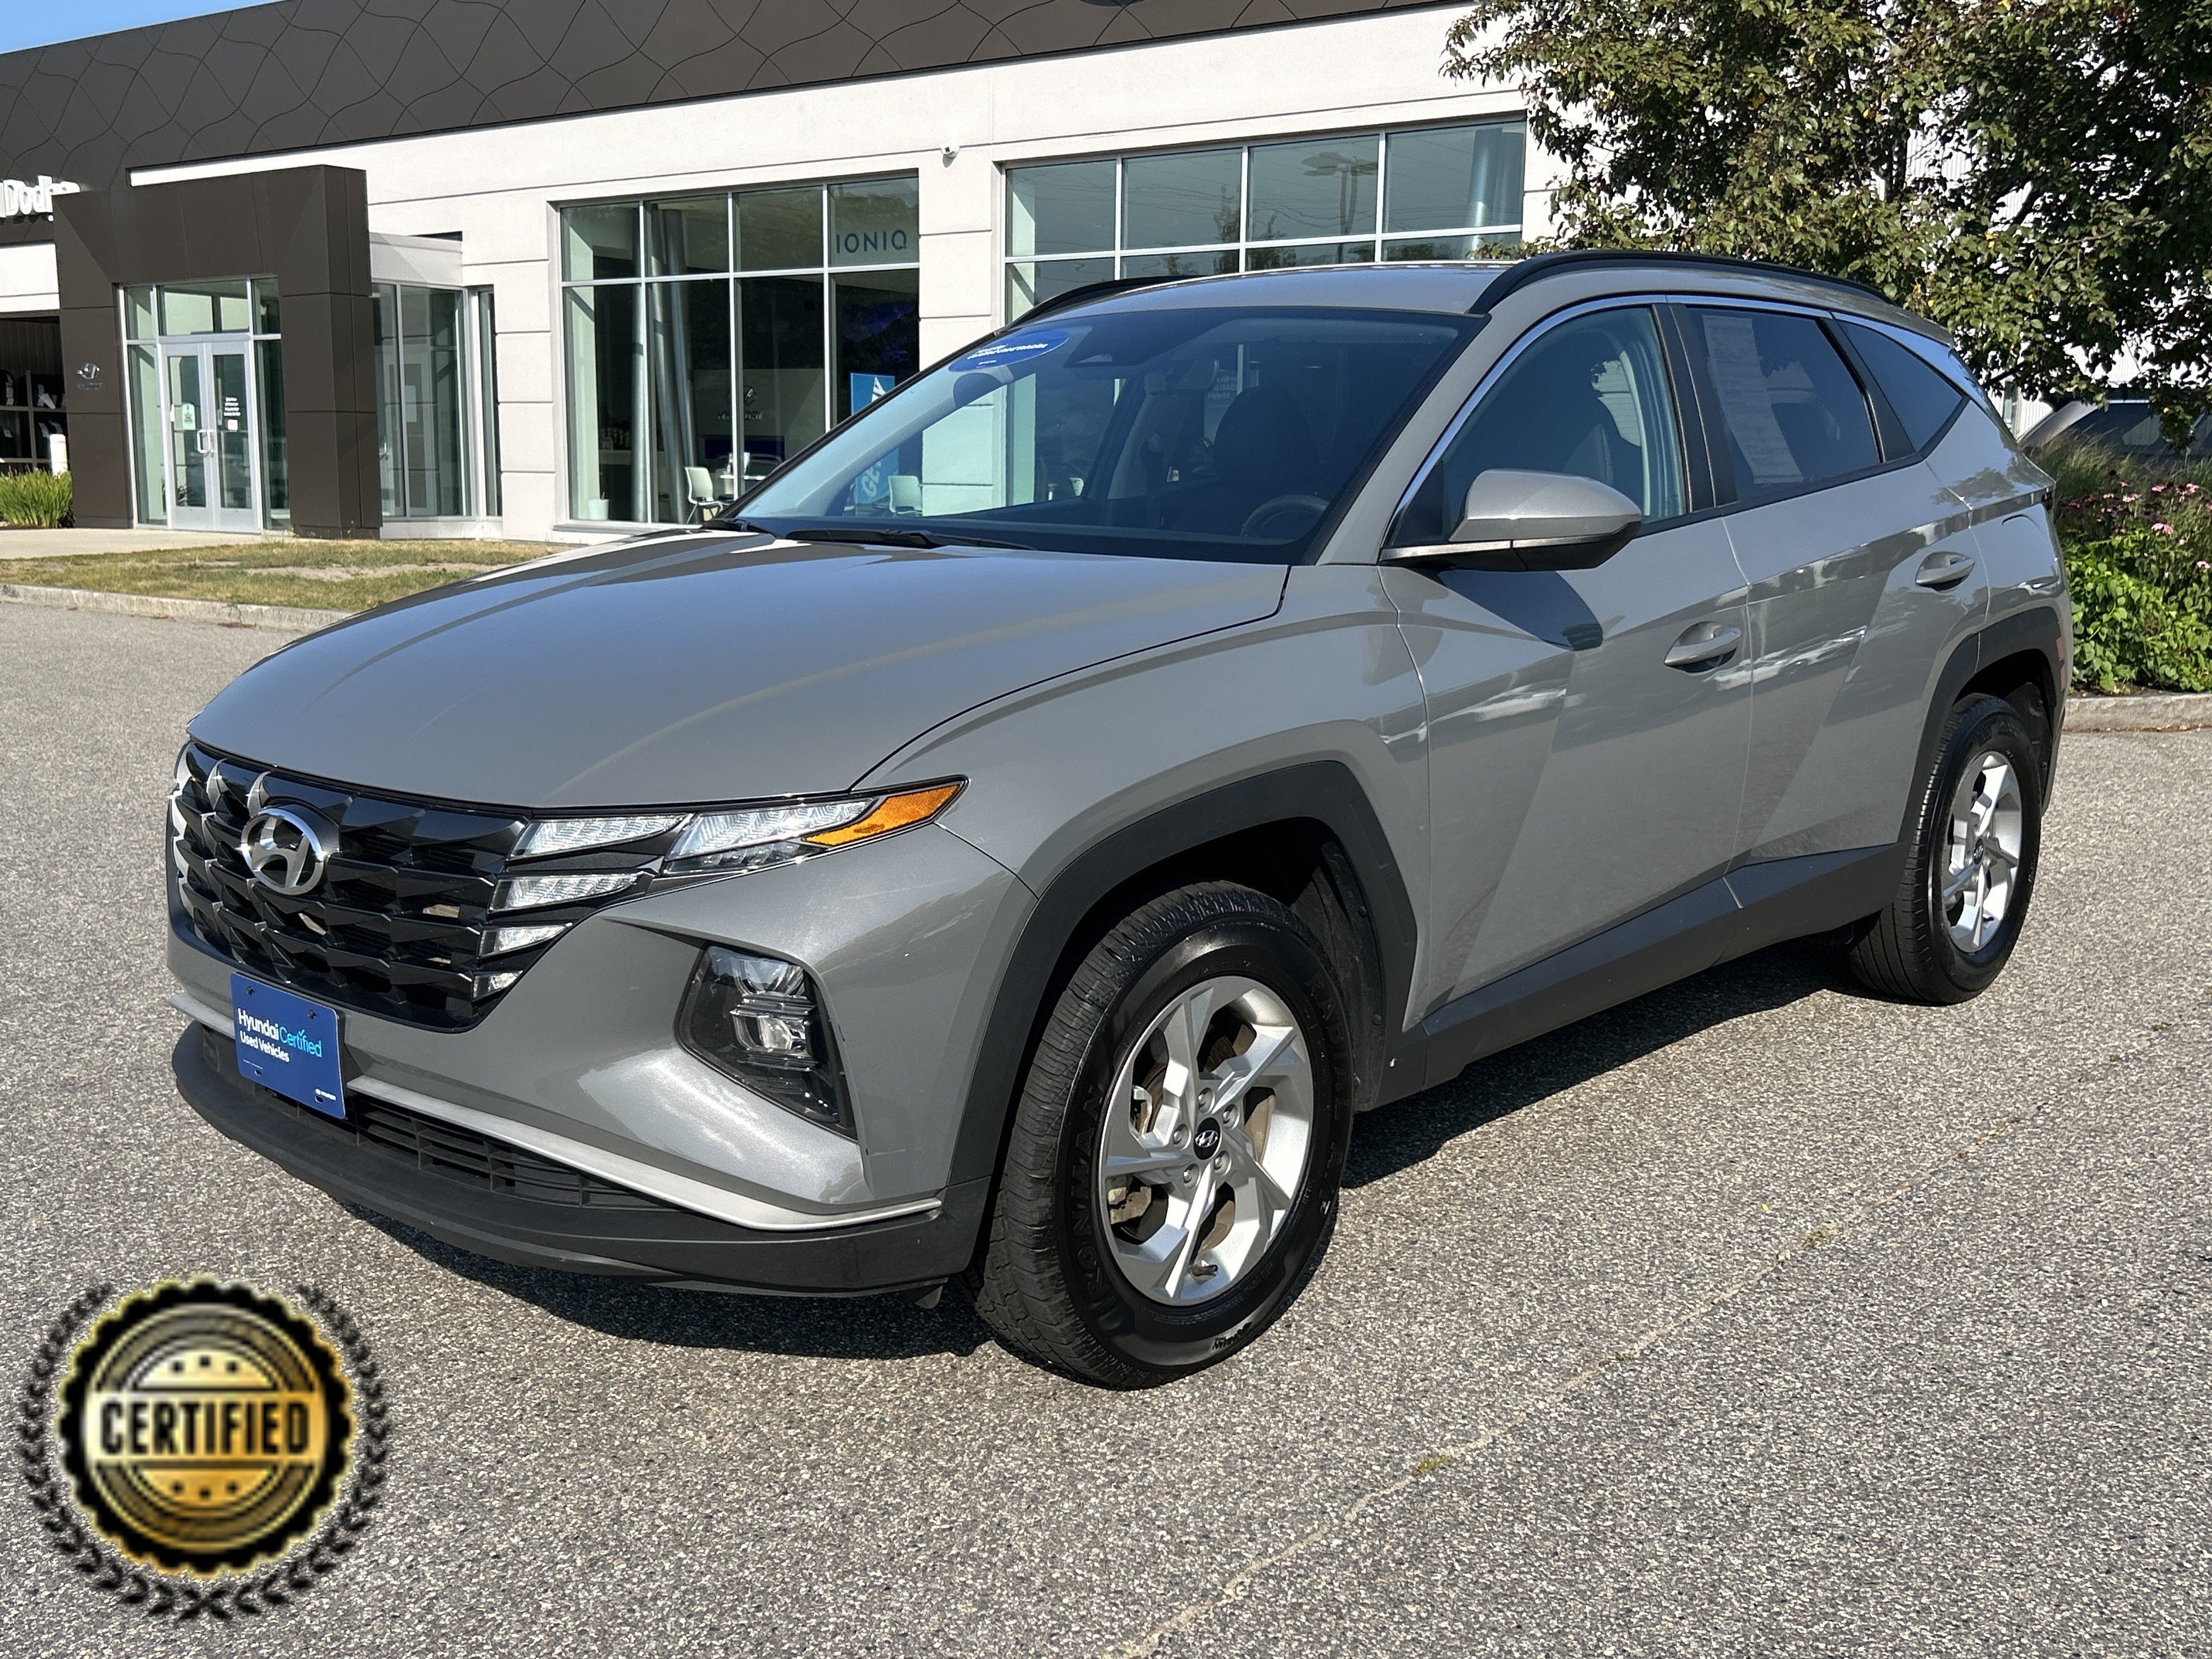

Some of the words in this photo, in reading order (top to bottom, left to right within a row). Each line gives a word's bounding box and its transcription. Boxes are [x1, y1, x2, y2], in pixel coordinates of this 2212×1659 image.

[836, 229, 907, 253] IONIQ
[238, 1008, 279, 1041] Hyundai
[279, 1026, 323, 1058] Certified
[240, 1030, 258, 1049] Used
[258, 1037, 290, 1063] Vehicles
